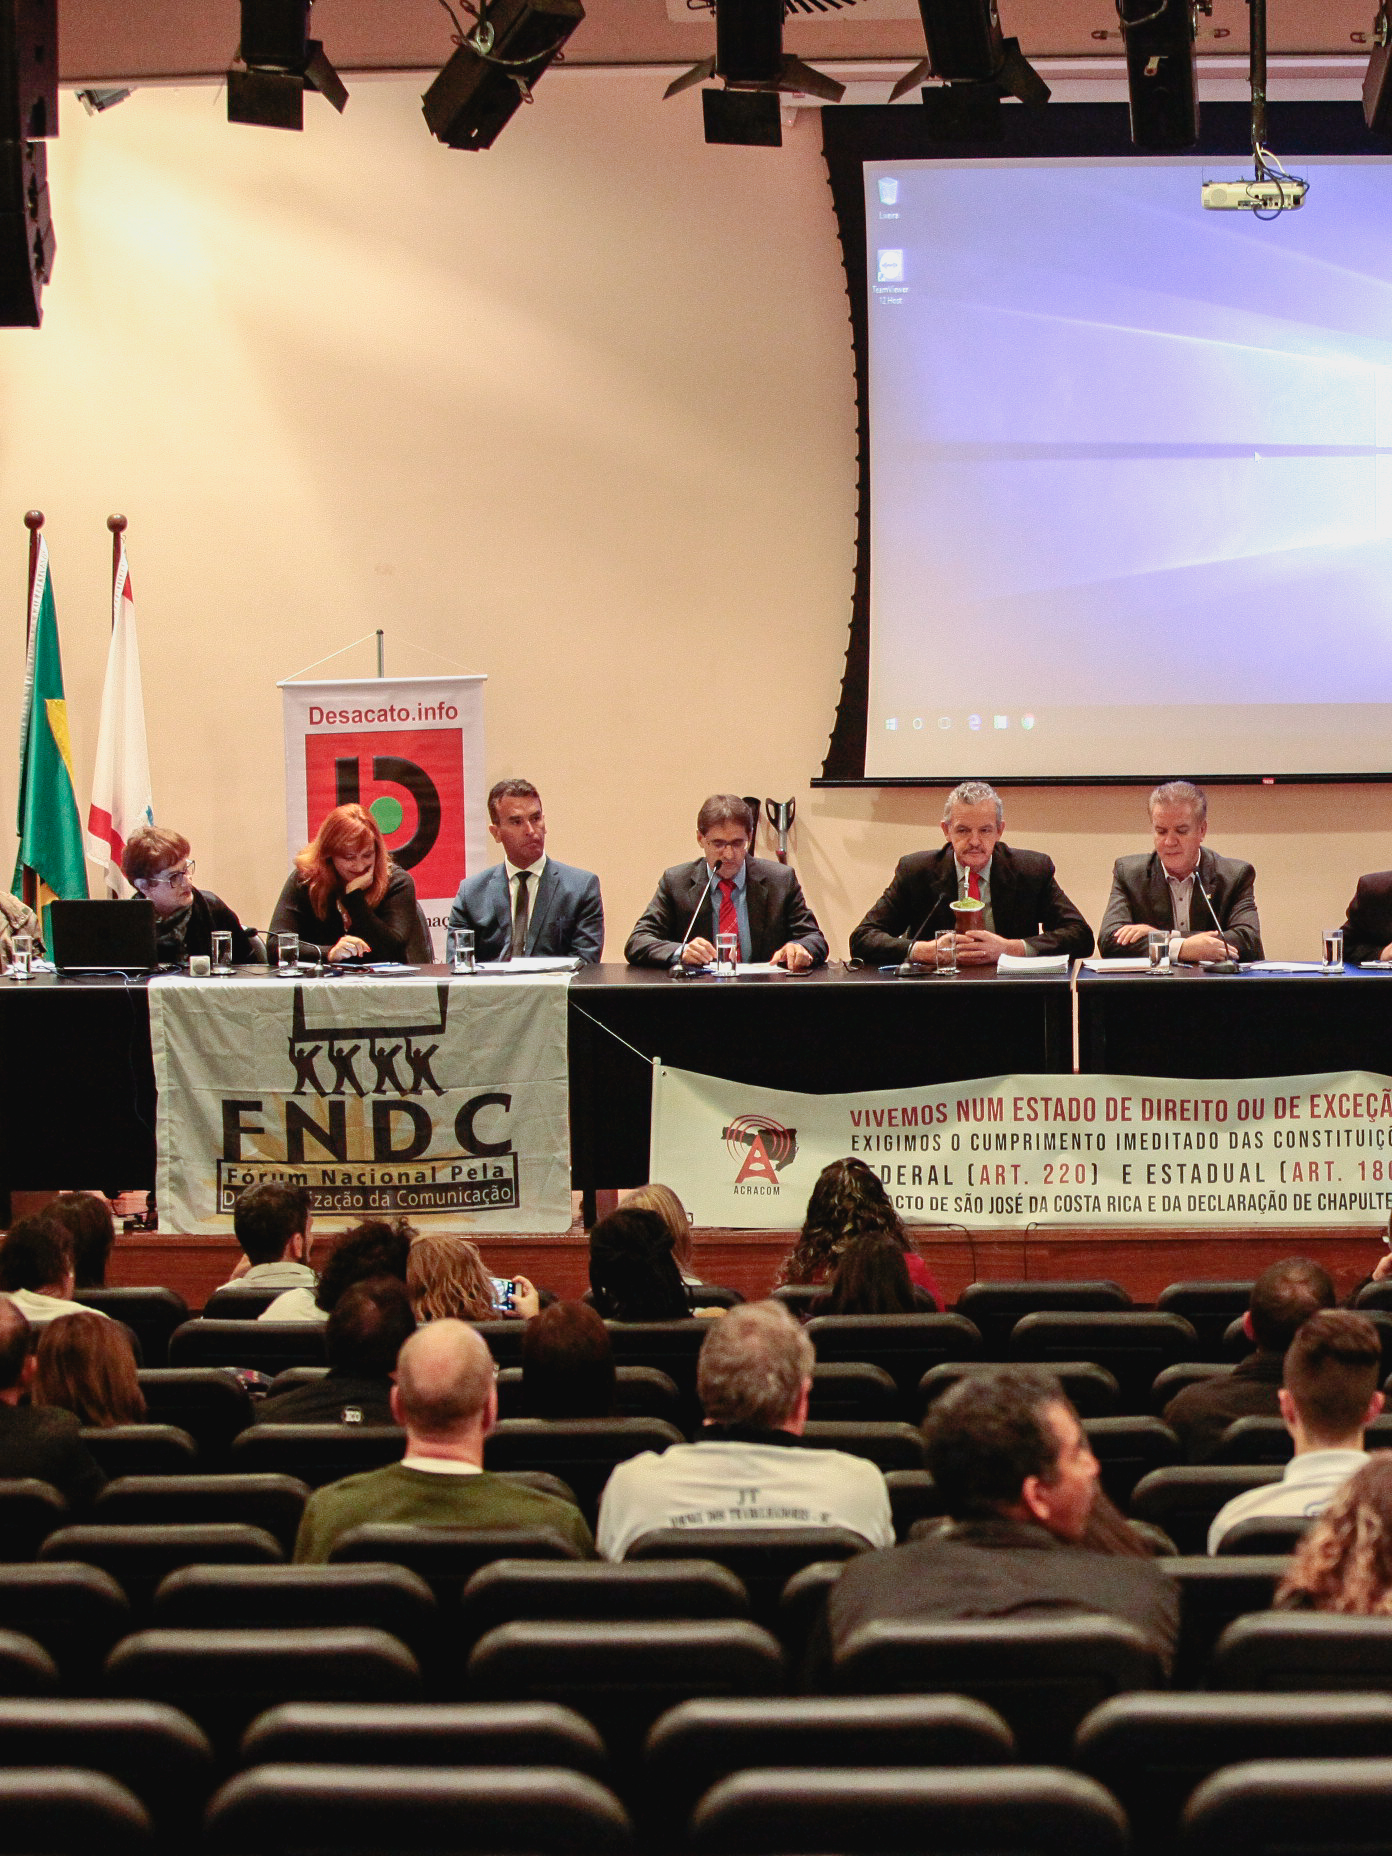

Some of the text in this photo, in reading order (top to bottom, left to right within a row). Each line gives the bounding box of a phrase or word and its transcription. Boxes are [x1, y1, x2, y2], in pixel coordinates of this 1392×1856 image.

[309, 702, 459, 725] Desacato.info
[850, 1102, 948, 1128] VIVEMOS
[956, 1096, 1004, 1123] NUM
[1013, 1096, 1096, 1122] ESTADO
[1105, 1096, 1133, 1122] DE
[1141, 1097, 1228, 1123] DIREITO
[1237, 1097, 1265, 1120] OU
[1274, 1096, 1301, 1119] DE
[221, 1092, 512, 1162] FNDC
[851, 1133, 942, 1151] EXIGIMOS
[951, 1133, 961, 1151] O
[970, 1132, 1106, 1151] CUMPRIMENTO
[1116, 1132, 1219, 1151] IMEDITADO
[1229, 1131, 1263, 1149] DAS
[321, 1165, 437, 1185] Nacional
[451, 1163, 504, 1181] Pela
[968, 1163, 1029, 1187] (ART.
[1043, 1162, 1098, 1186] 220)
[1122, 1163, 1132, 1185] E
[1146, 1161, 1266, 1185] ESTADUAL
[1280, 1160, 1343, 1184] (ART.
[370, 1189, 391, 1207] da
[397, 1184, 511, 1208] Comunicação
[733, 1185, 780, 1195] ACRACOM
[930, 1196, 949, 1212] DE
[954, 1192, 983, 1214] SÃO
[989, 1192, 1023, 1215] JOSÉ
[1029, 1195, 1048, 1214] DA
[1053, 1194, 1101, 1213] COSTA
[1107, 1194, 1142, 1213] RICA
[1147, 1194, 1157, 1212] E
[1162, 1194, 1182, 1213] DA
[1187, 1190, 1288, 1215] DECLARAÇÃO
[1293, 1193, 1312, 1212] DE
